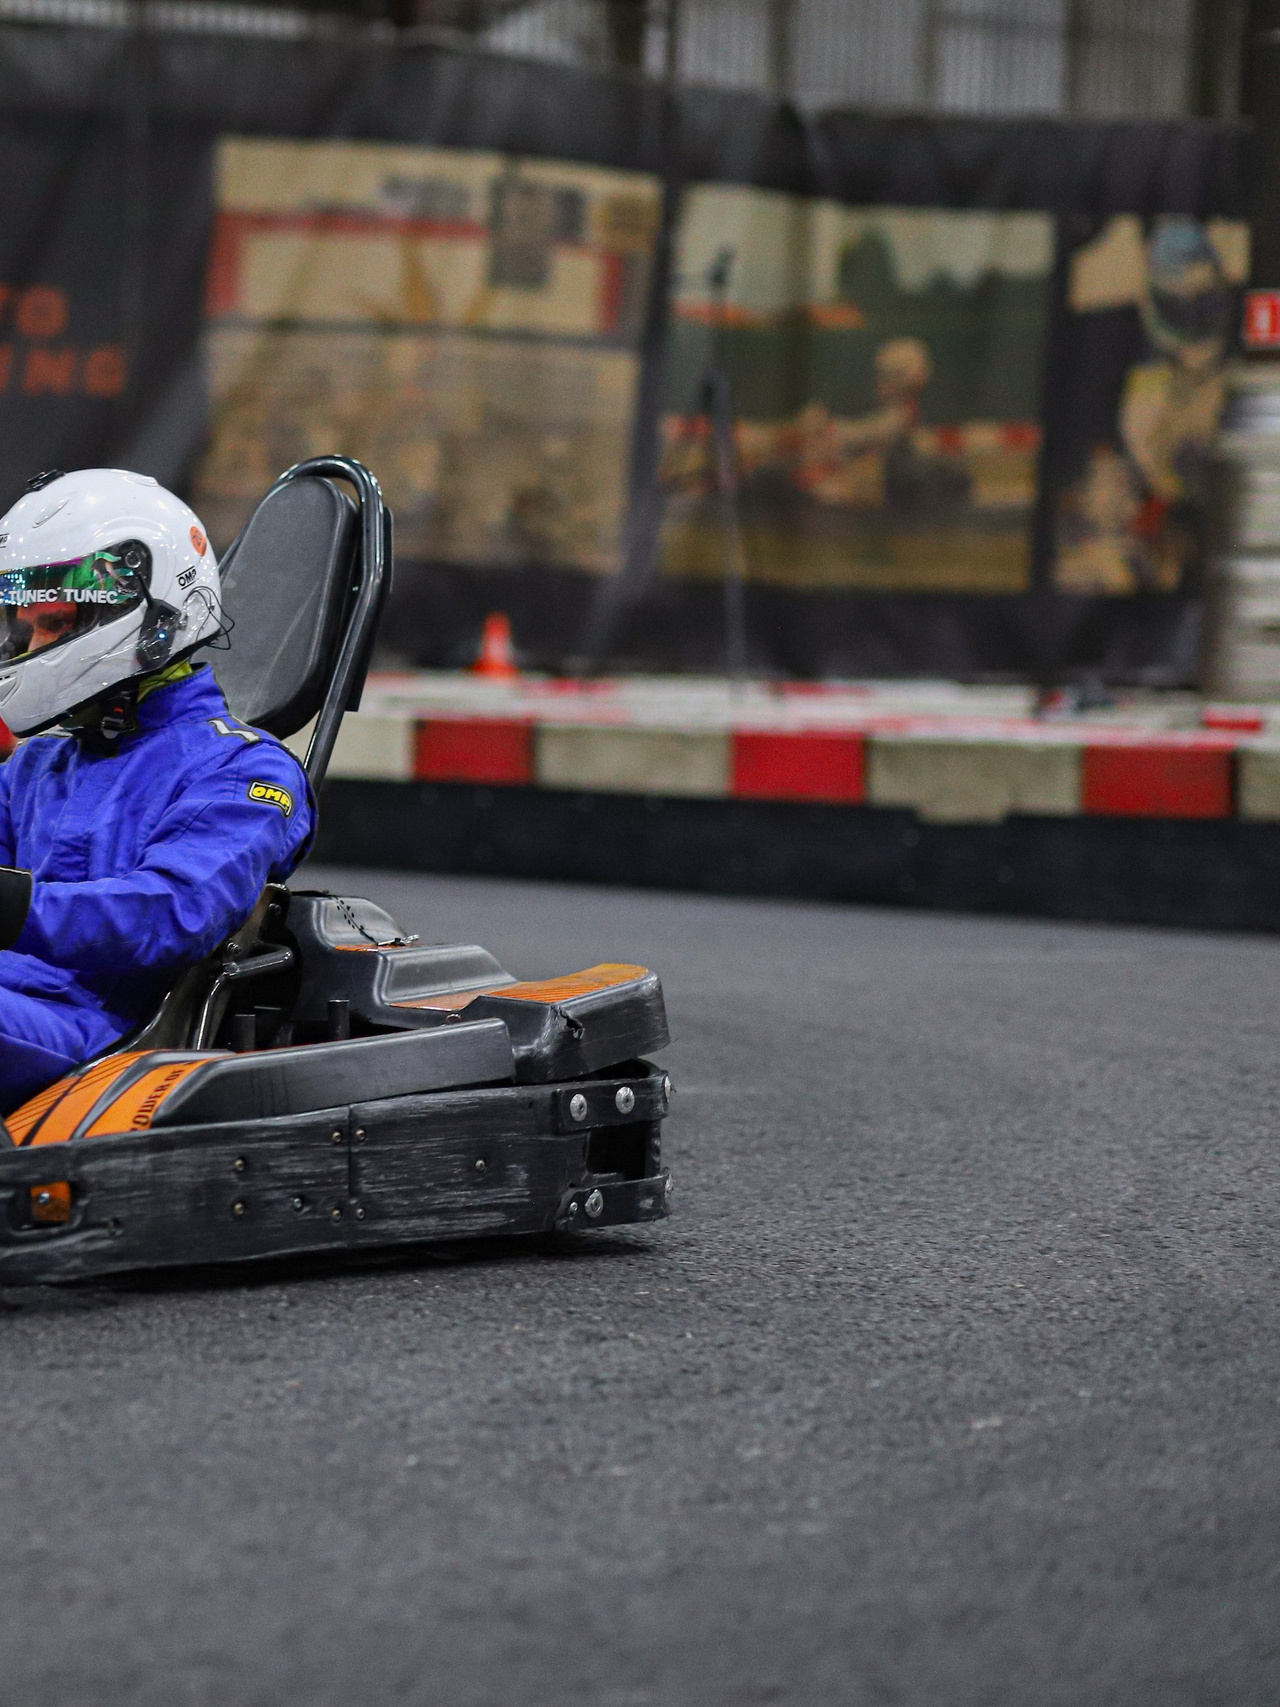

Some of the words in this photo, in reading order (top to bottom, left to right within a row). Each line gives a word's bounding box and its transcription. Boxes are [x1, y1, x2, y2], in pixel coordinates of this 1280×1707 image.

[178, 569, 197, 586] OMP
[8, 588, 58, 603] TUNEC
[63, 588, 119, 604] TUNEC
[252, 786, 290, 809] OMP
[130, 1083, 171, 1131] OWER
